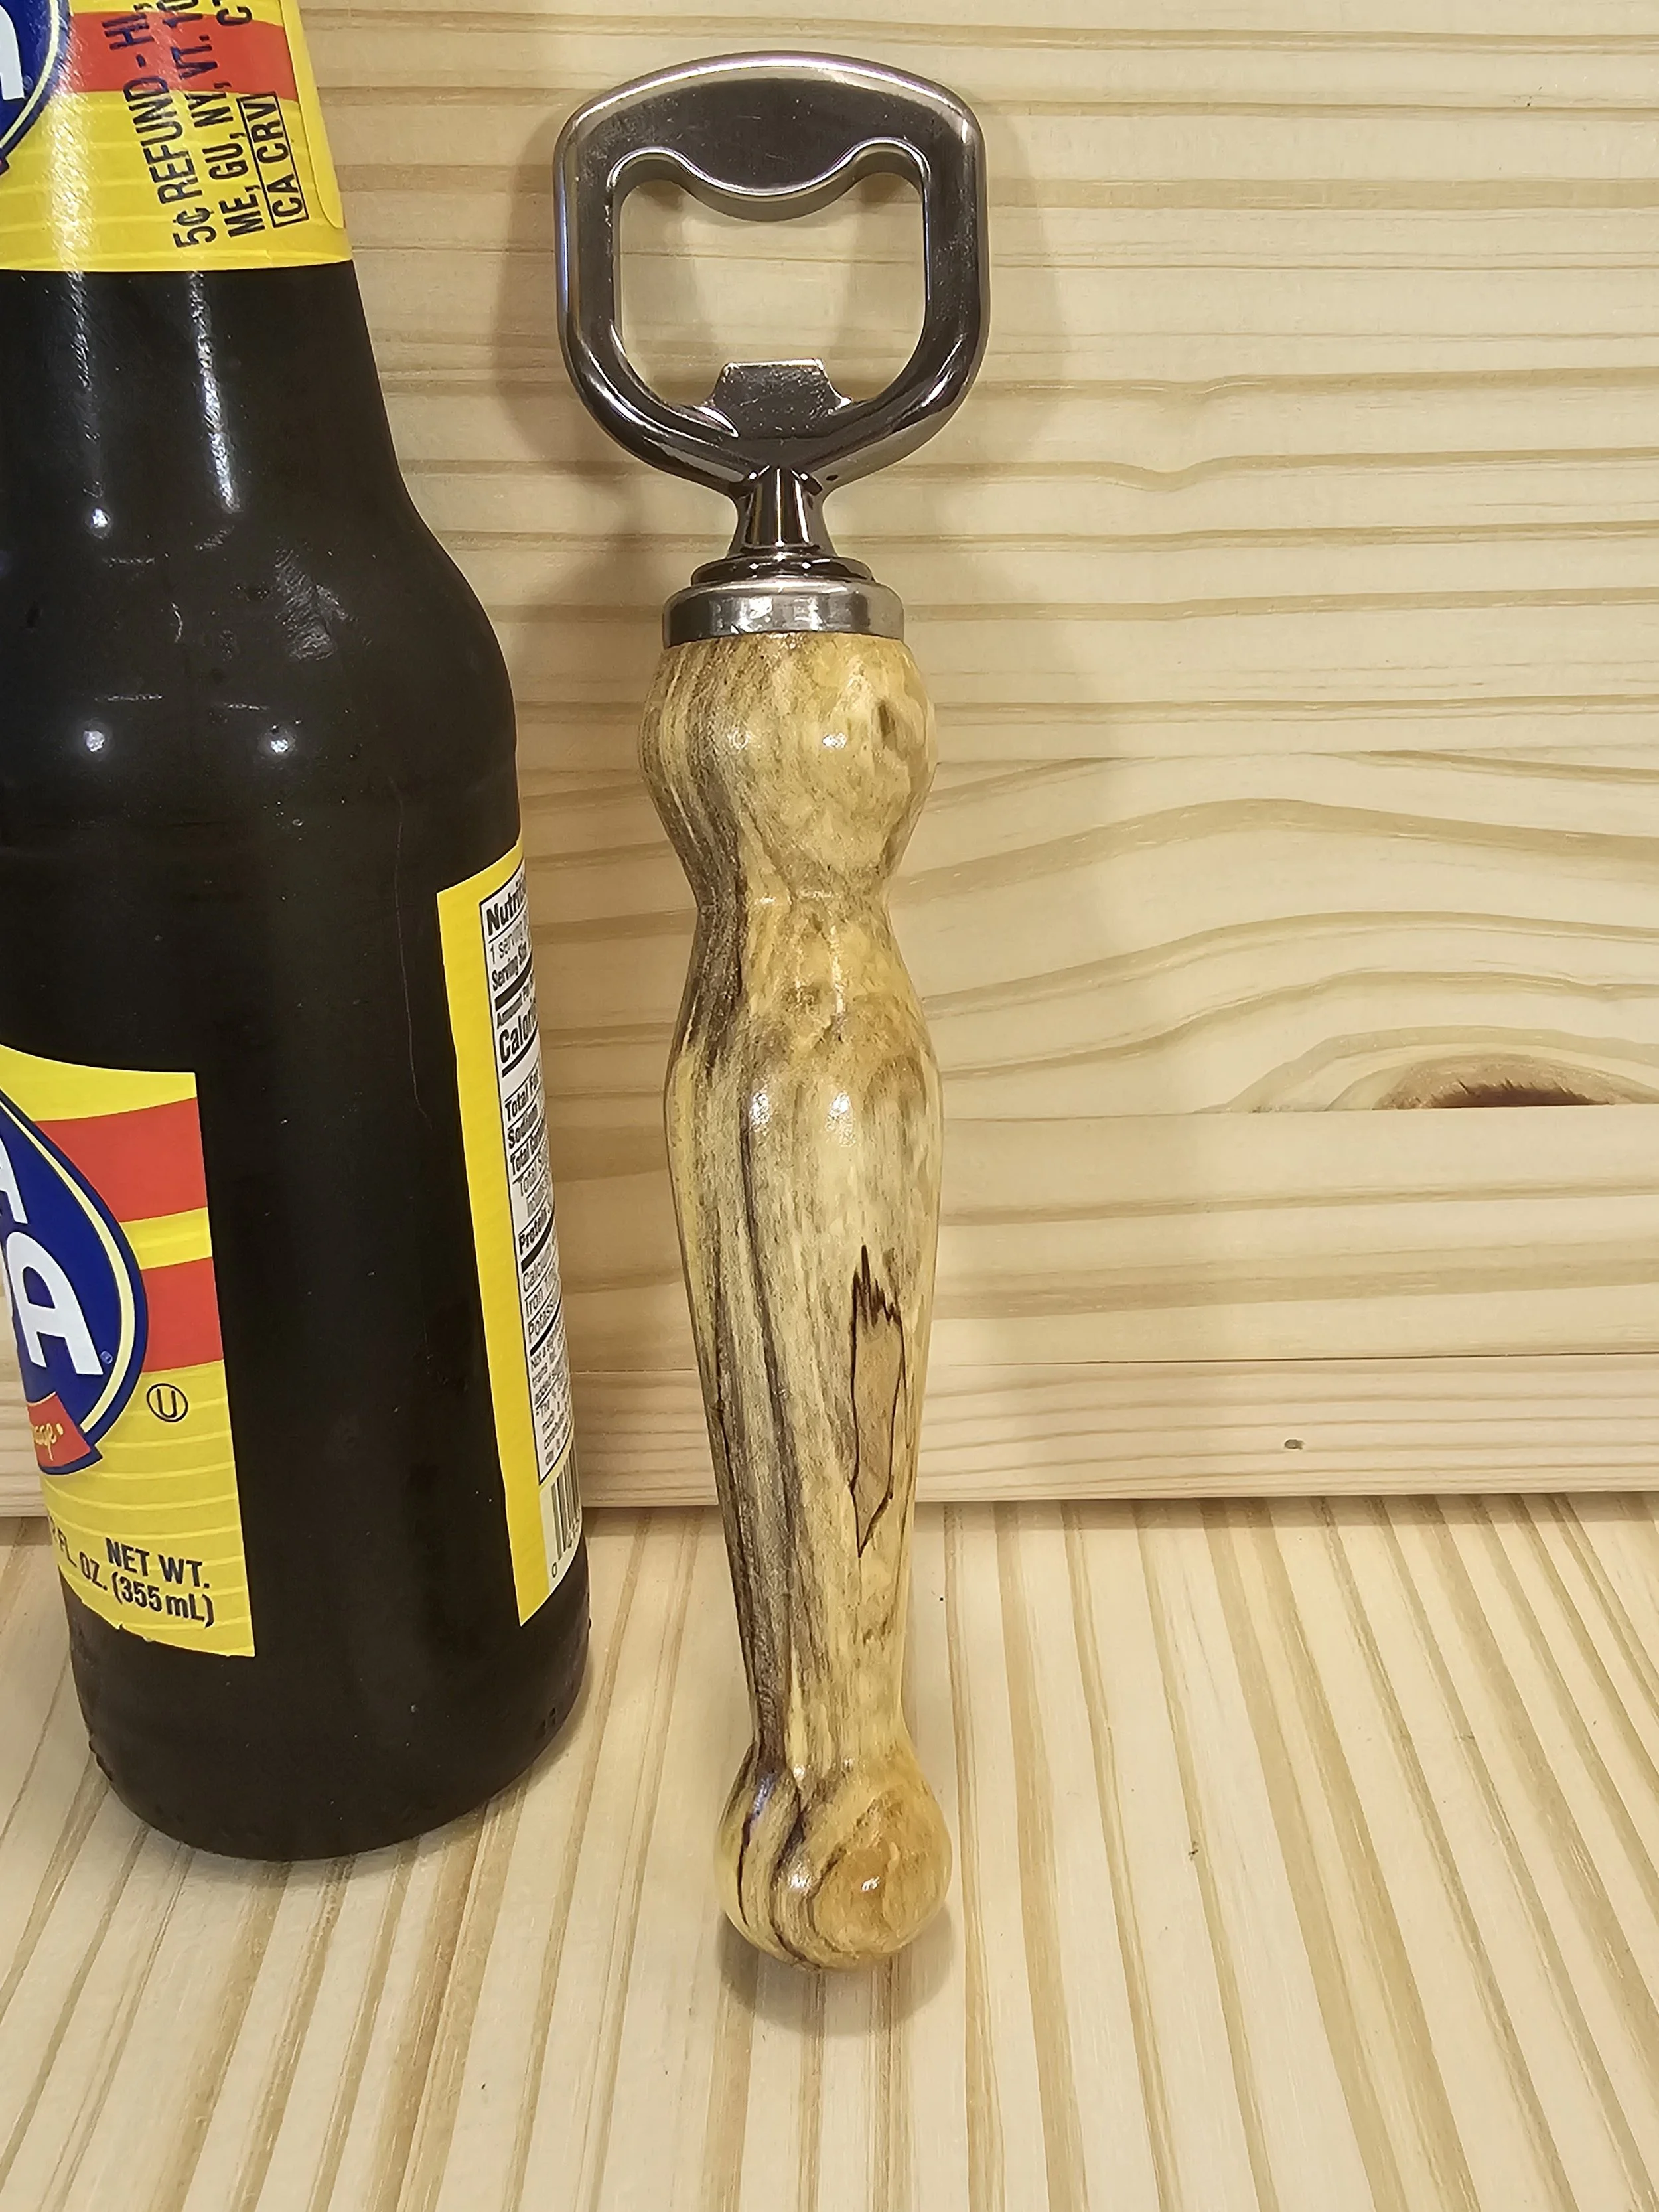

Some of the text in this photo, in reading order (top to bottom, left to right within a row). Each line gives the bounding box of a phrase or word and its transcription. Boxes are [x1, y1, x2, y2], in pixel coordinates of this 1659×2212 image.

[171, 35, 218, 79] VT.
[184, 82, 234, 128] NY,
[123, 76, 202, 204] REFUND
[253, 98, 291, 164] CRV
[202, 132, 248, 181] GU,
[219, 185, 265, 237] ME,
[265, 174, 304, 219] CA
[173, 206, 216, 248] 5¢
[505, 1083, 529, 1121] Total
[79, 1551, 108, 1591] OZ.
[105, 1537, 210, 1589] NET WT.
